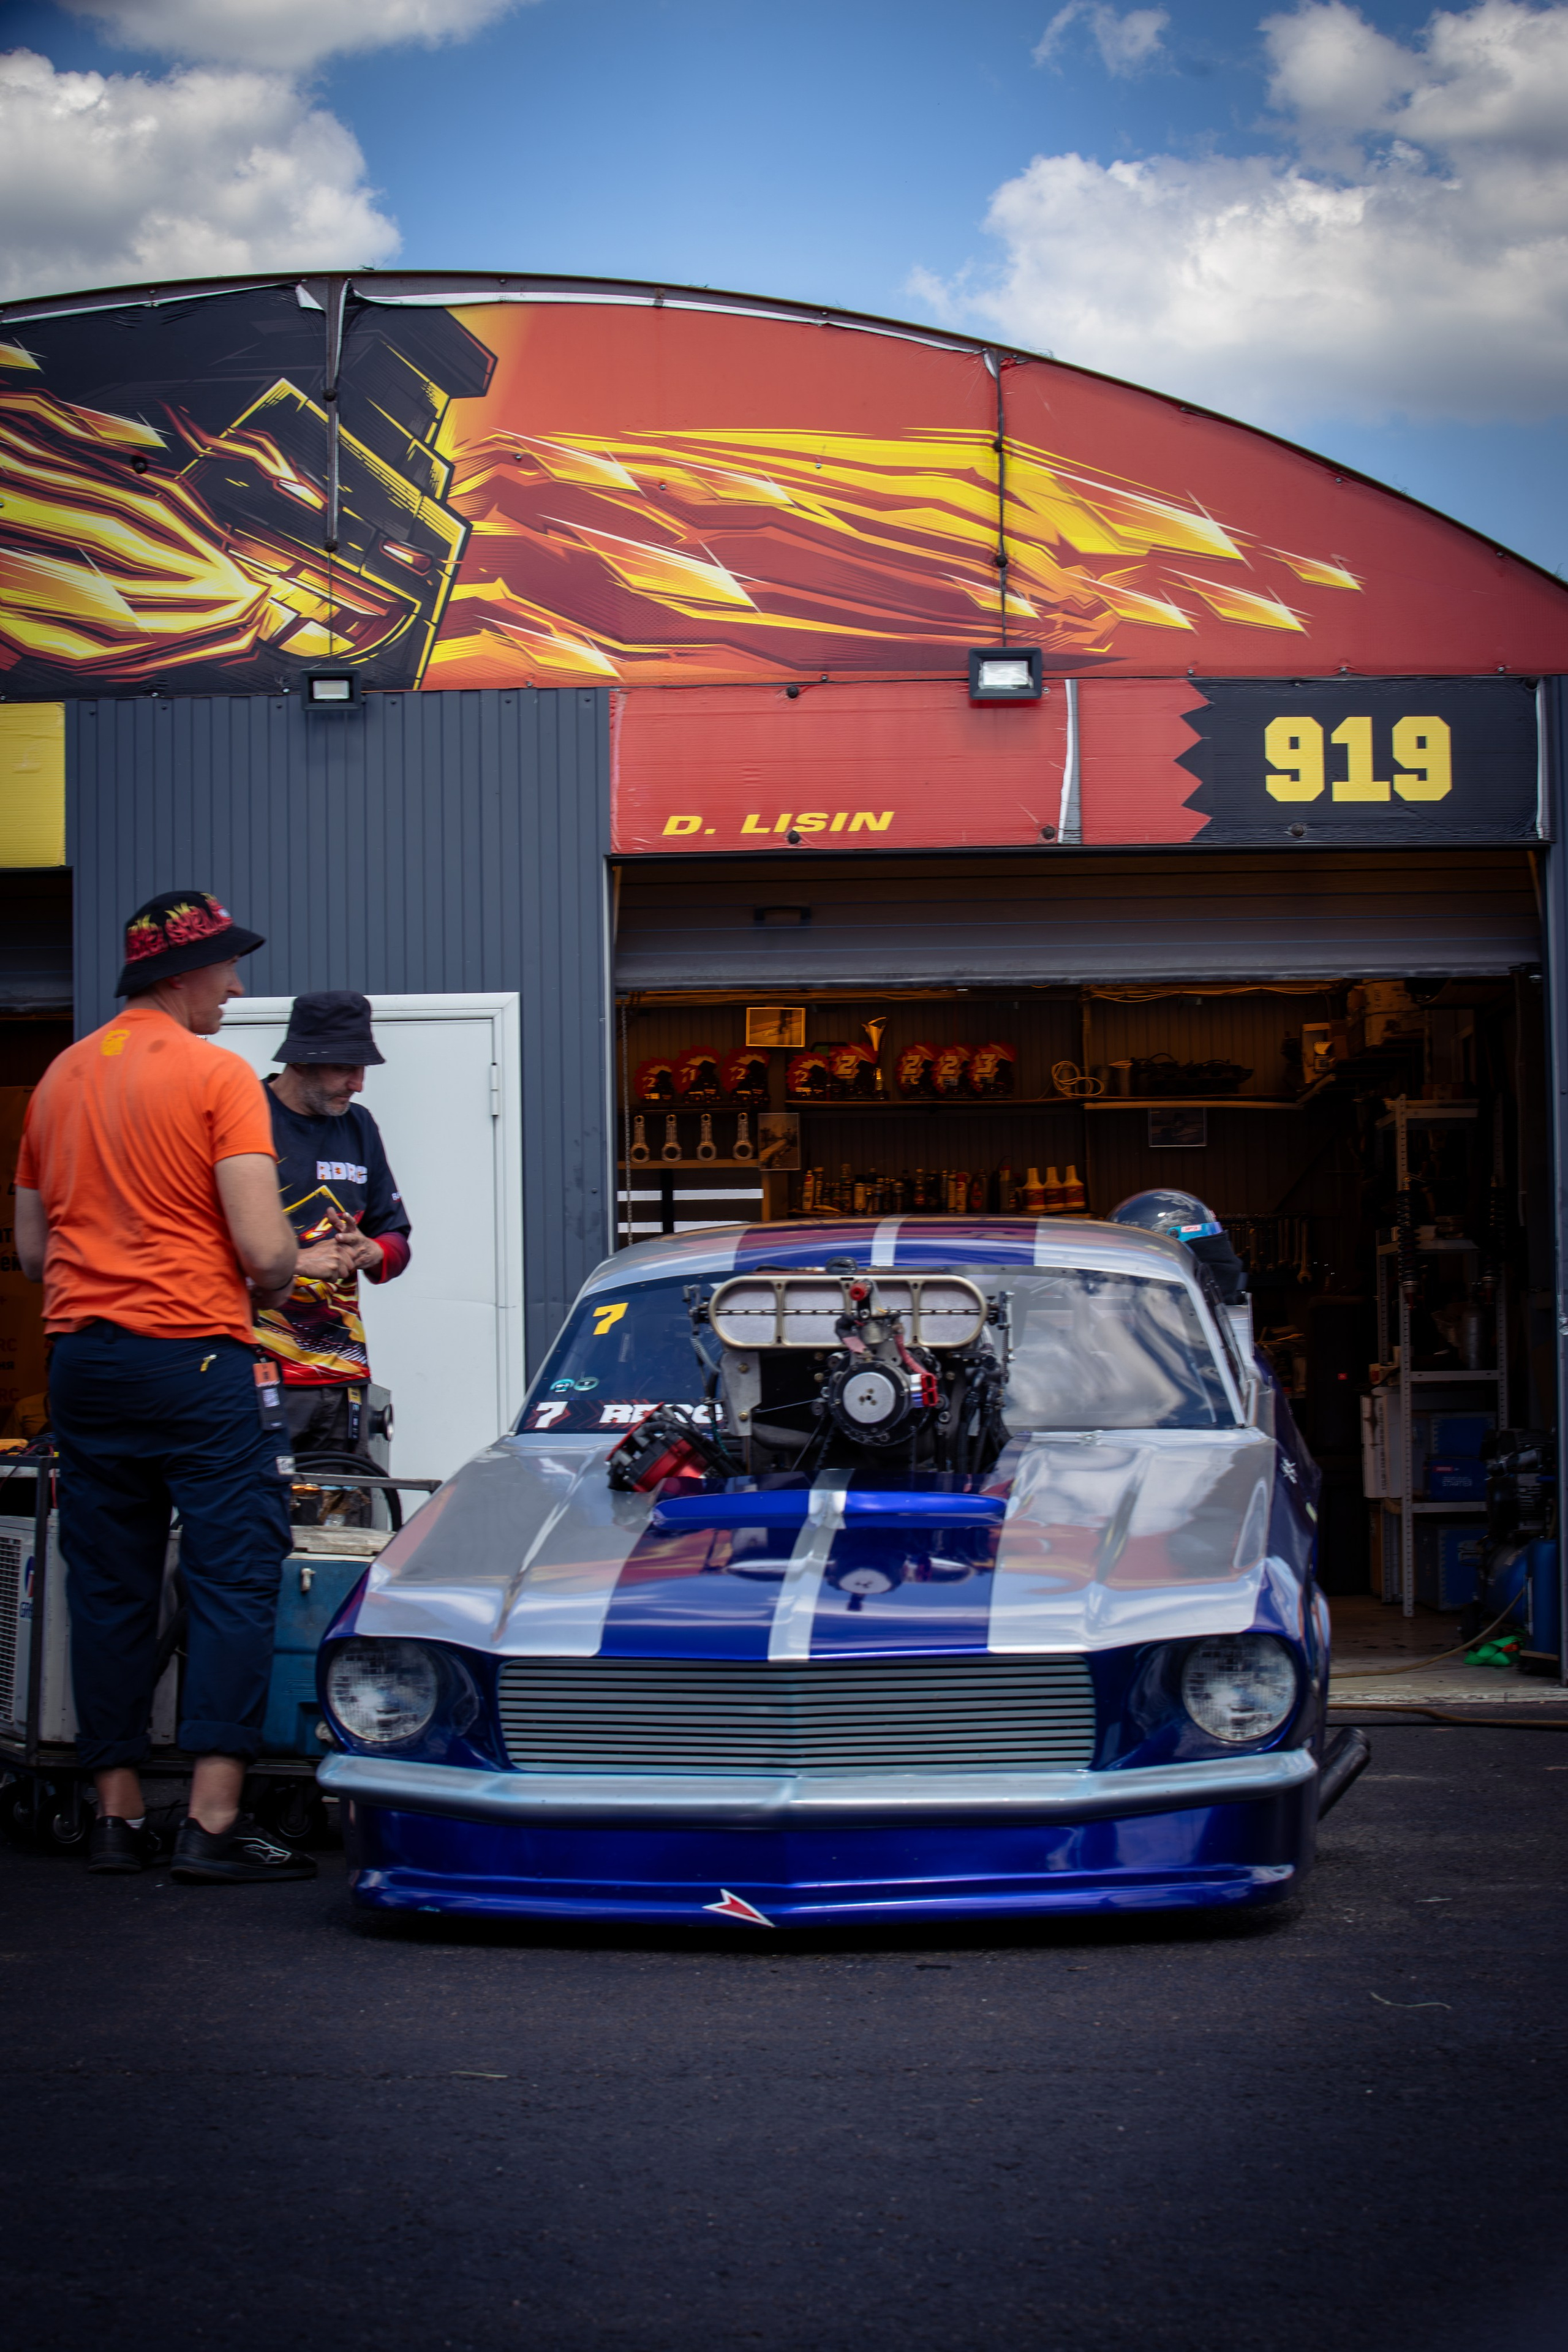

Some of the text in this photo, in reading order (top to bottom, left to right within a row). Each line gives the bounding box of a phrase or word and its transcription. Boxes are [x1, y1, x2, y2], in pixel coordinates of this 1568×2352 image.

[1264, 716, 1452, 802] 919
[662, 812, 895, 835] D. LISIN
[838, 1055, 858, 1075] 2
[902, 1054, 921, 1075] 2
[940, 1055, 959, 1075] 2
[976, 1054, 997, 1073] 3
[646, 1077, 657, 1088] 2
[735, 1068, 747, 1080] 2
[798, 1071, 809, 1082] 2
[592, 1302, 629, 1335] 7
[534, 1401, 568, 1428] 7
